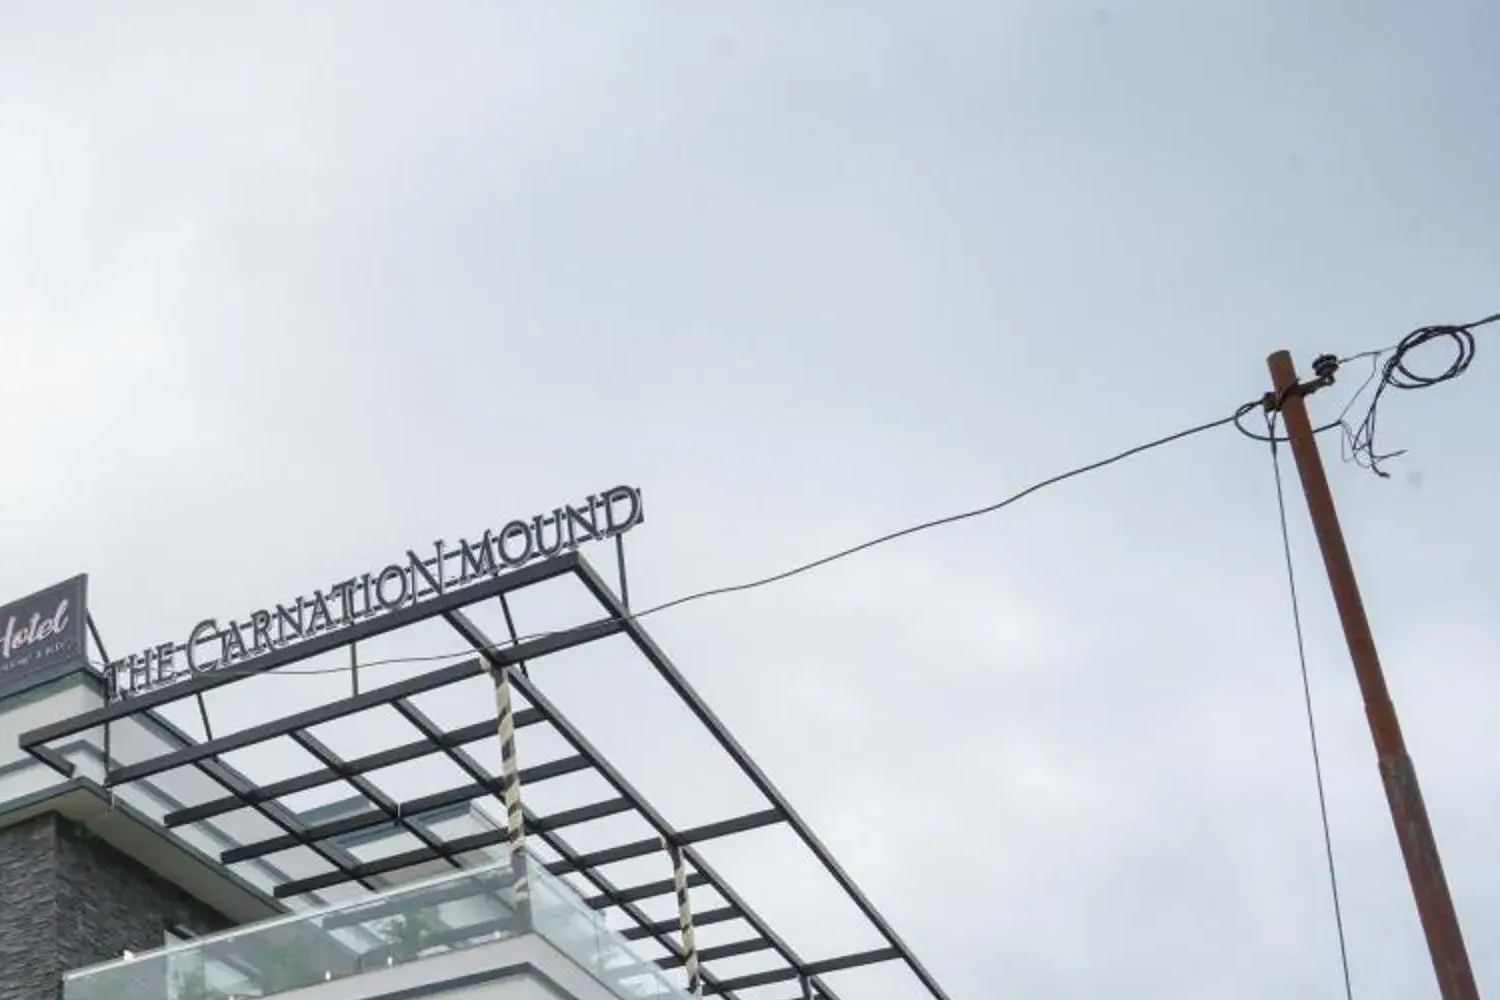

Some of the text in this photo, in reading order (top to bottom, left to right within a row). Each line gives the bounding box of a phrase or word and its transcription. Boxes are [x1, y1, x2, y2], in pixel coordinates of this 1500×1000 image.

[103, 641, 177, 702] THE
[186, 539, 445, 678] CARNATION
[459, 484, 642, 584] MOUND
